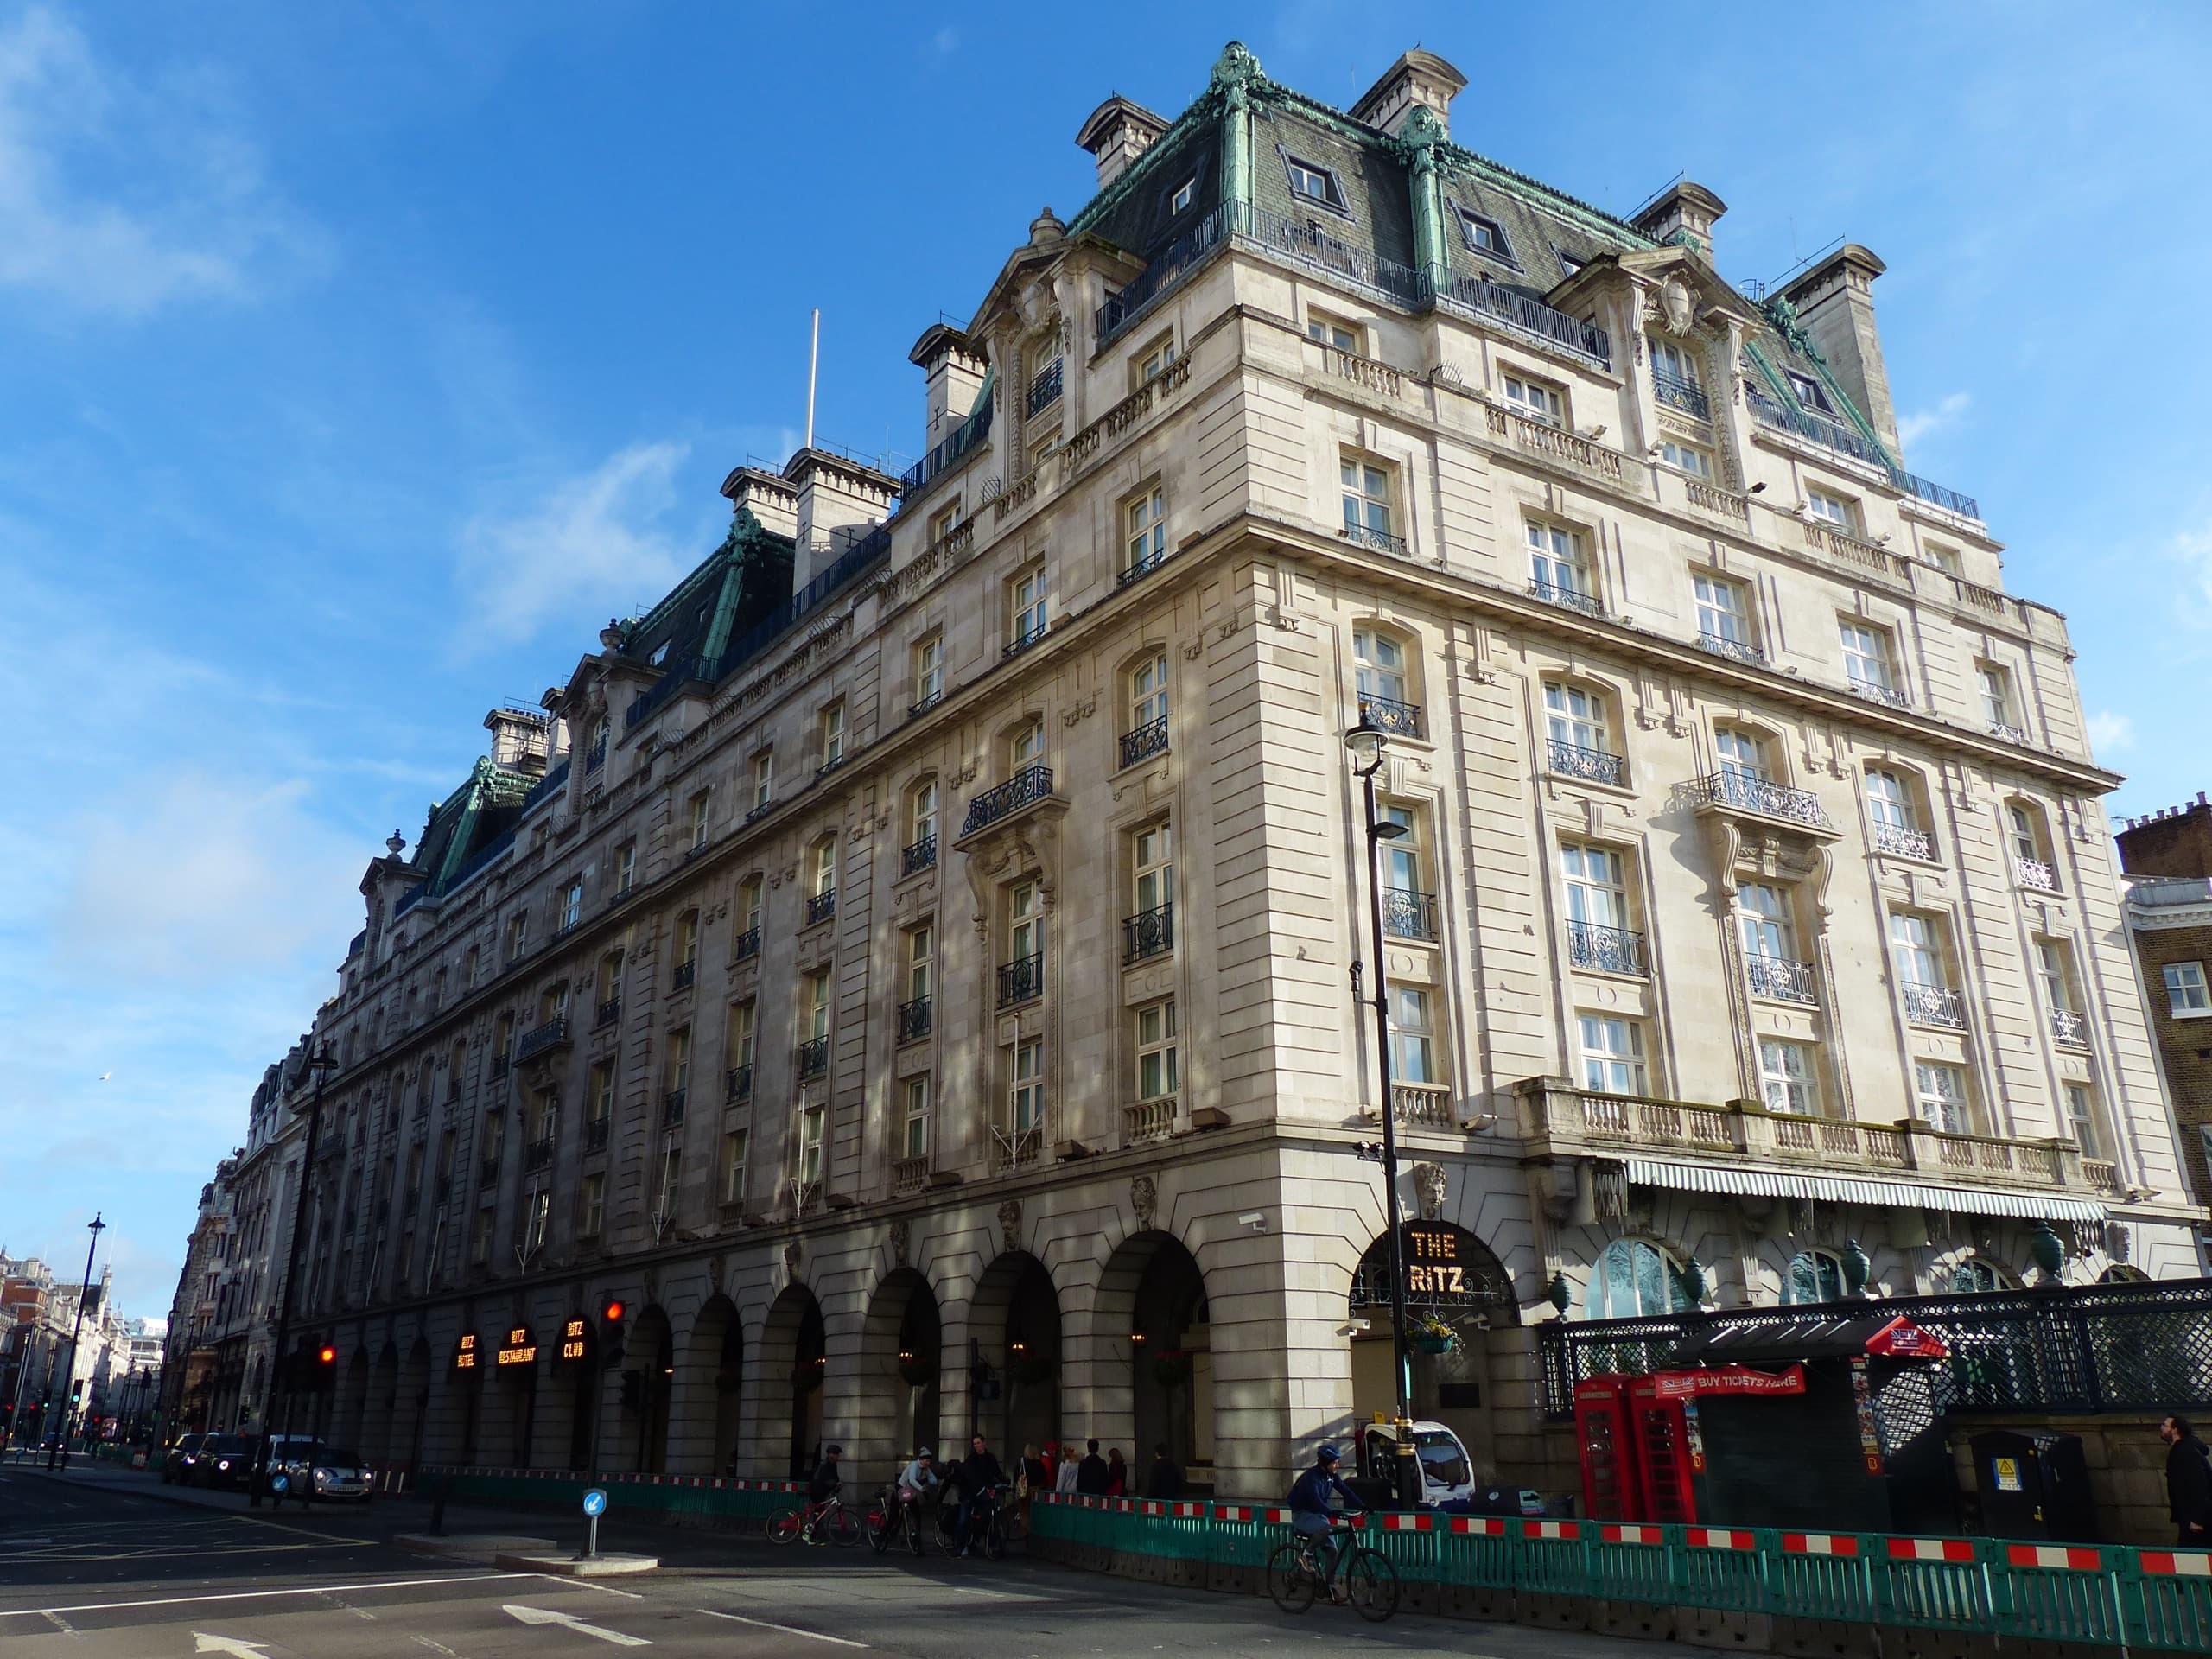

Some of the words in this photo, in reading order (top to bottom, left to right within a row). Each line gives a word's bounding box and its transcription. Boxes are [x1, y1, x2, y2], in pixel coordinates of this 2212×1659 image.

[1411, 1231, 1456, 1258] THE
[1409, 1264, 1465, 1293] RITZ
[511, 1329, 525, 1344] RITZ
[567, 1320, 583, 1337] RITZ
[499, 1347, 536, 1364] RESTAURANT
[563, 1341, 583, 1357] CLUB
[1698, 1376, 1720, 1388] BUY
[1722, 1376, 1764, 1387] TICKETS
[1765, 1375, 1797, 1388] HERE
